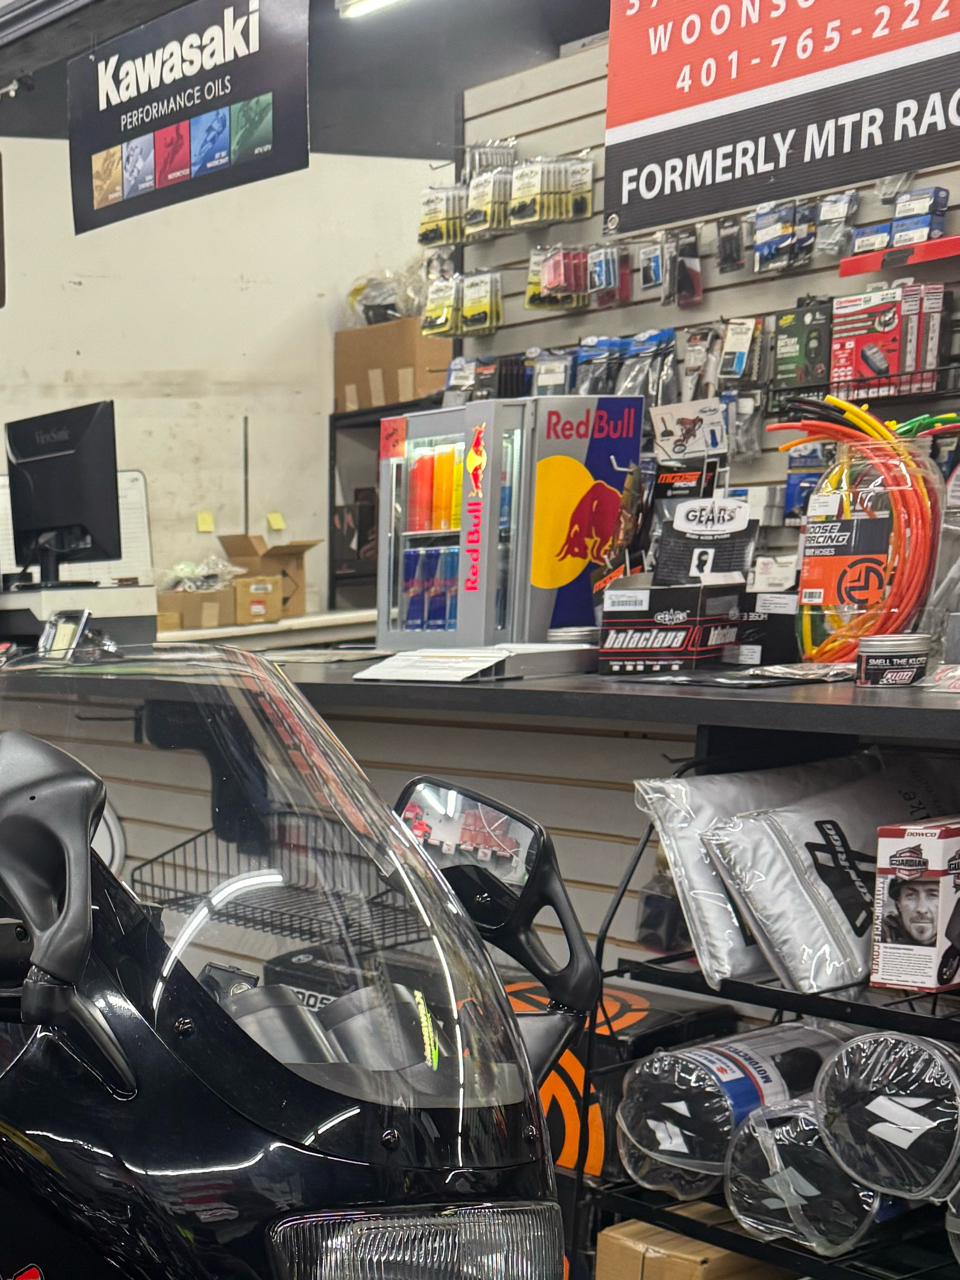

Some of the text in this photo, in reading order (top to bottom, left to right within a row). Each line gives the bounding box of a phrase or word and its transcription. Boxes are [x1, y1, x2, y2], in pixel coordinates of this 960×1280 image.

[98, 0, 260, 111] Kawasaki
[120, 75, 232, 131] PERFORMANCE OILS
[622, 129, 796, 205] FORMERLY
[804, 108, 883, 162] MTR
[546, 408, 635, 440] Red Bull
[686, 500, 737, 530] GEARS
[464, 501, 483, 591] Red Bull
[604, 628, 688, 649] balaclava
[868, 658, 891, 666] SMELL
[890, 858, 928, 868] GUARDIAN
[870, 877, 884, 975] MOTORCYCLE COVER
